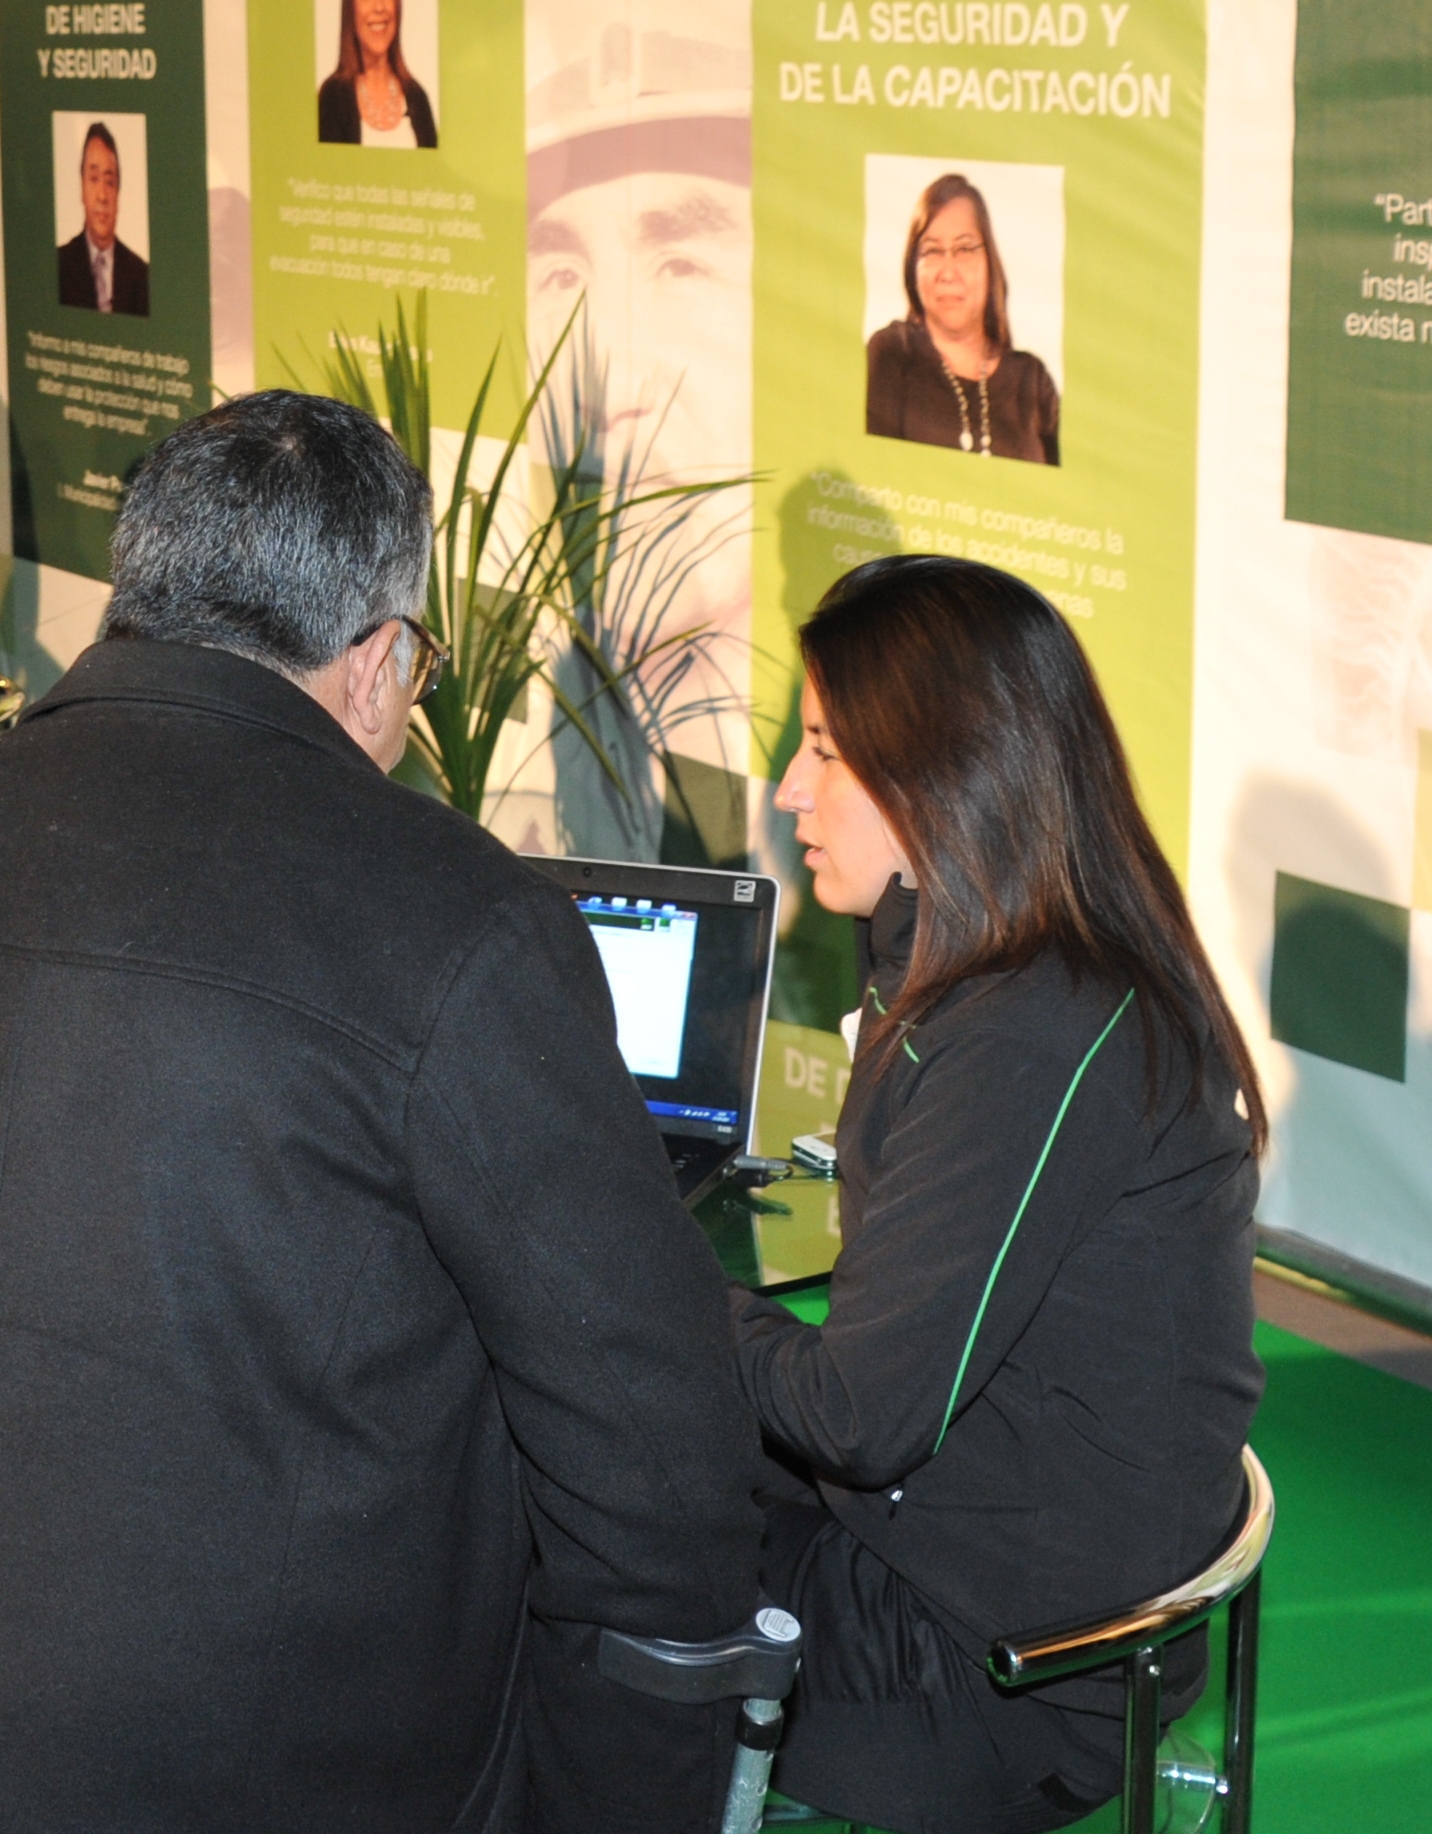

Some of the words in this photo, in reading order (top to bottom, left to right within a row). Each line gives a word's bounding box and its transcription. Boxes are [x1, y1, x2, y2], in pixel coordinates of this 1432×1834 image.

[46, 5, 70, 34] DE
[72, 3, 146, 34] HIGIENE
[815, 1, 860, 43] LA
[869, 1, 1088, 47] SEGURIDAD
[1099, 4, 1130, 48] Y
[37, 48, 50, 77] Y
[53, 48, 156, 79] SEGURIDAD
[779, 61, 824, 103] DE
[832, 63, 876, 105] LA
[884, 61, 1171, 118] CAPACITACIÓN
[1345, 309, 1415, 342] exista
[808, 501, 905, 543] información
[908, 523, 932, 550] de
[936, 528, 964, 557] los
[967, 538, 1070, 579] accidentes
[1073, 561, 1087, 588] y
[1091, 564, 1127, 591] sus
[906, 493, 941, 517] con
[945, 500, 977, 526] mis
[981, 509, 1101, 551] compañeros
[1106, 527, 1124, 555] la
[784, 1046, 828, 1098] DE
